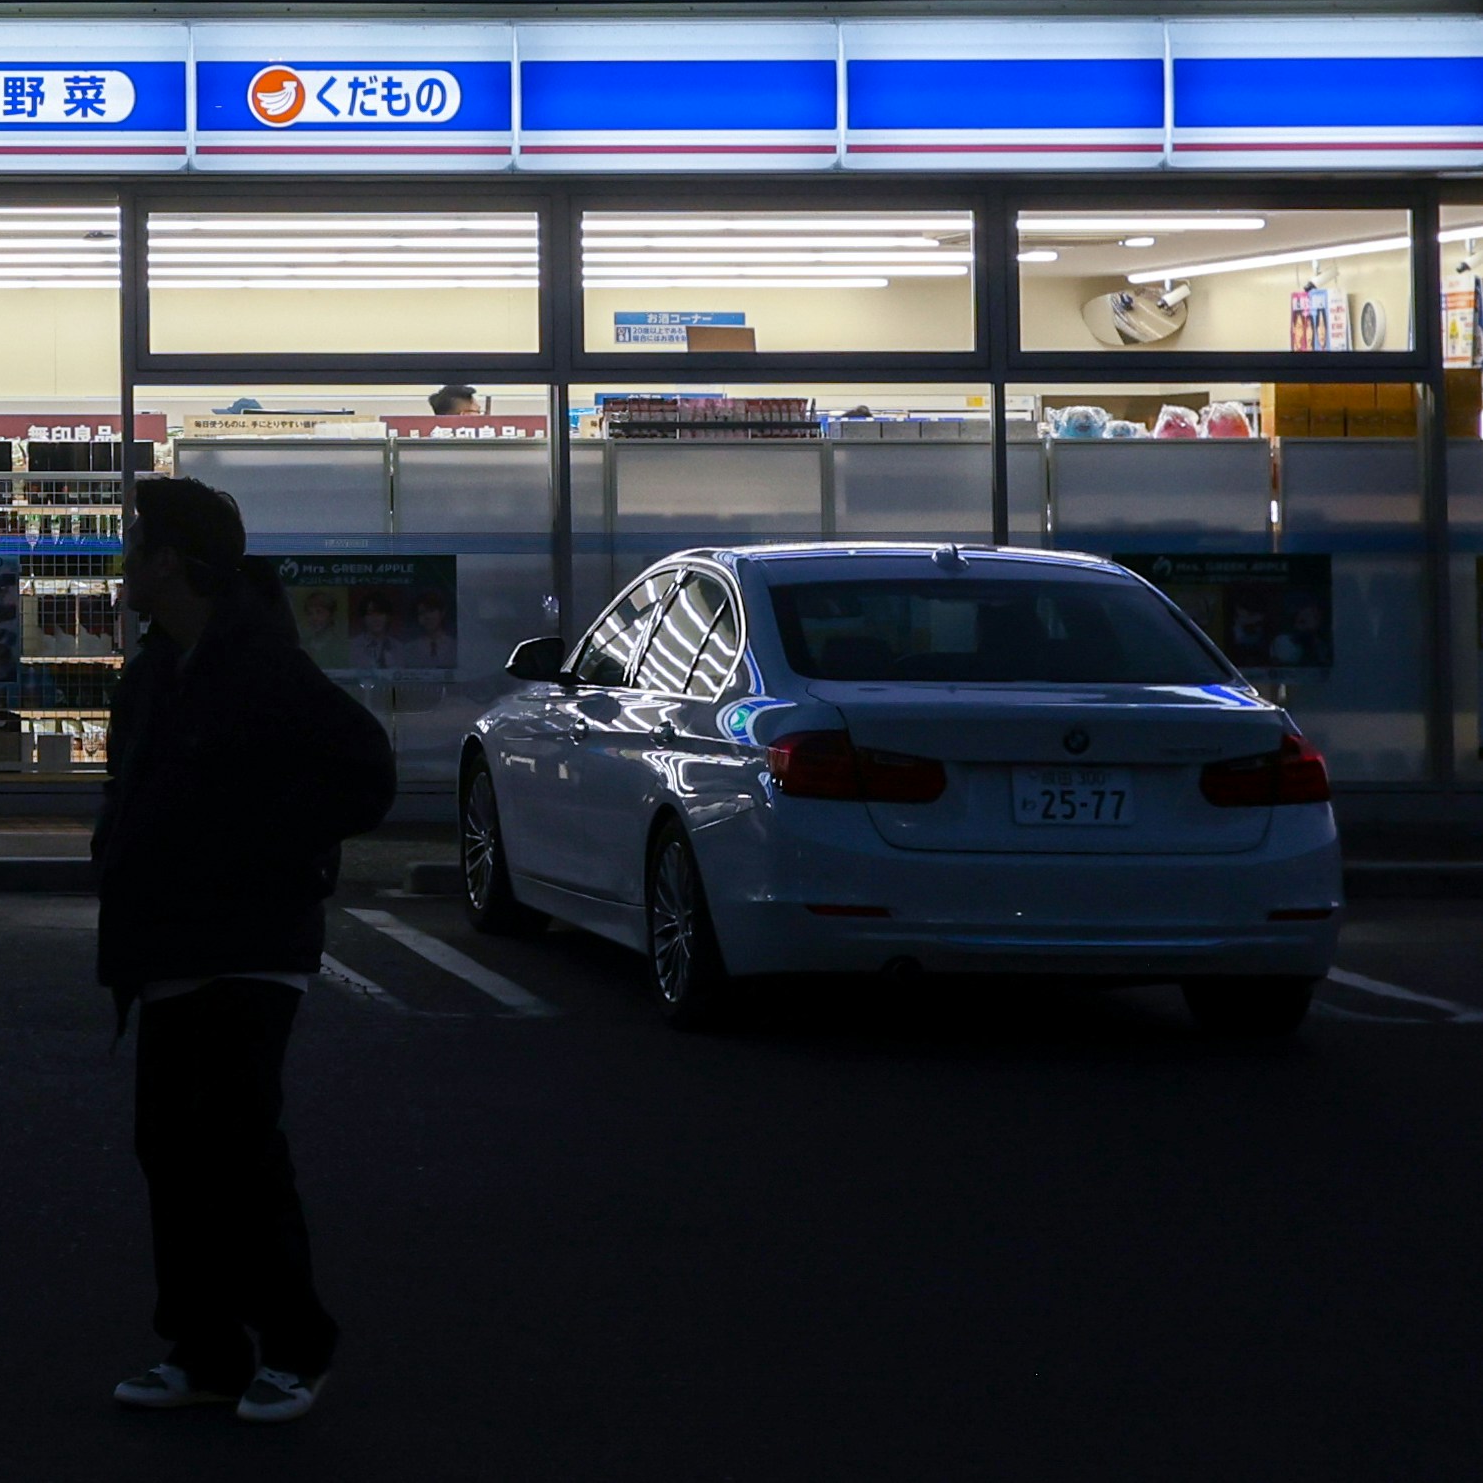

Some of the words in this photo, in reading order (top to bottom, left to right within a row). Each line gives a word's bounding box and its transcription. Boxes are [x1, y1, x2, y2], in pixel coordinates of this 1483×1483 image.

[2, 74, 107, 118] 野菜
[314, 76, 447, 116] くだもの
[331, 563, 373, 574] GREEN
[375, 563, 414, 574] APPLE
[1041, 789, 1126, 820] 25-77
